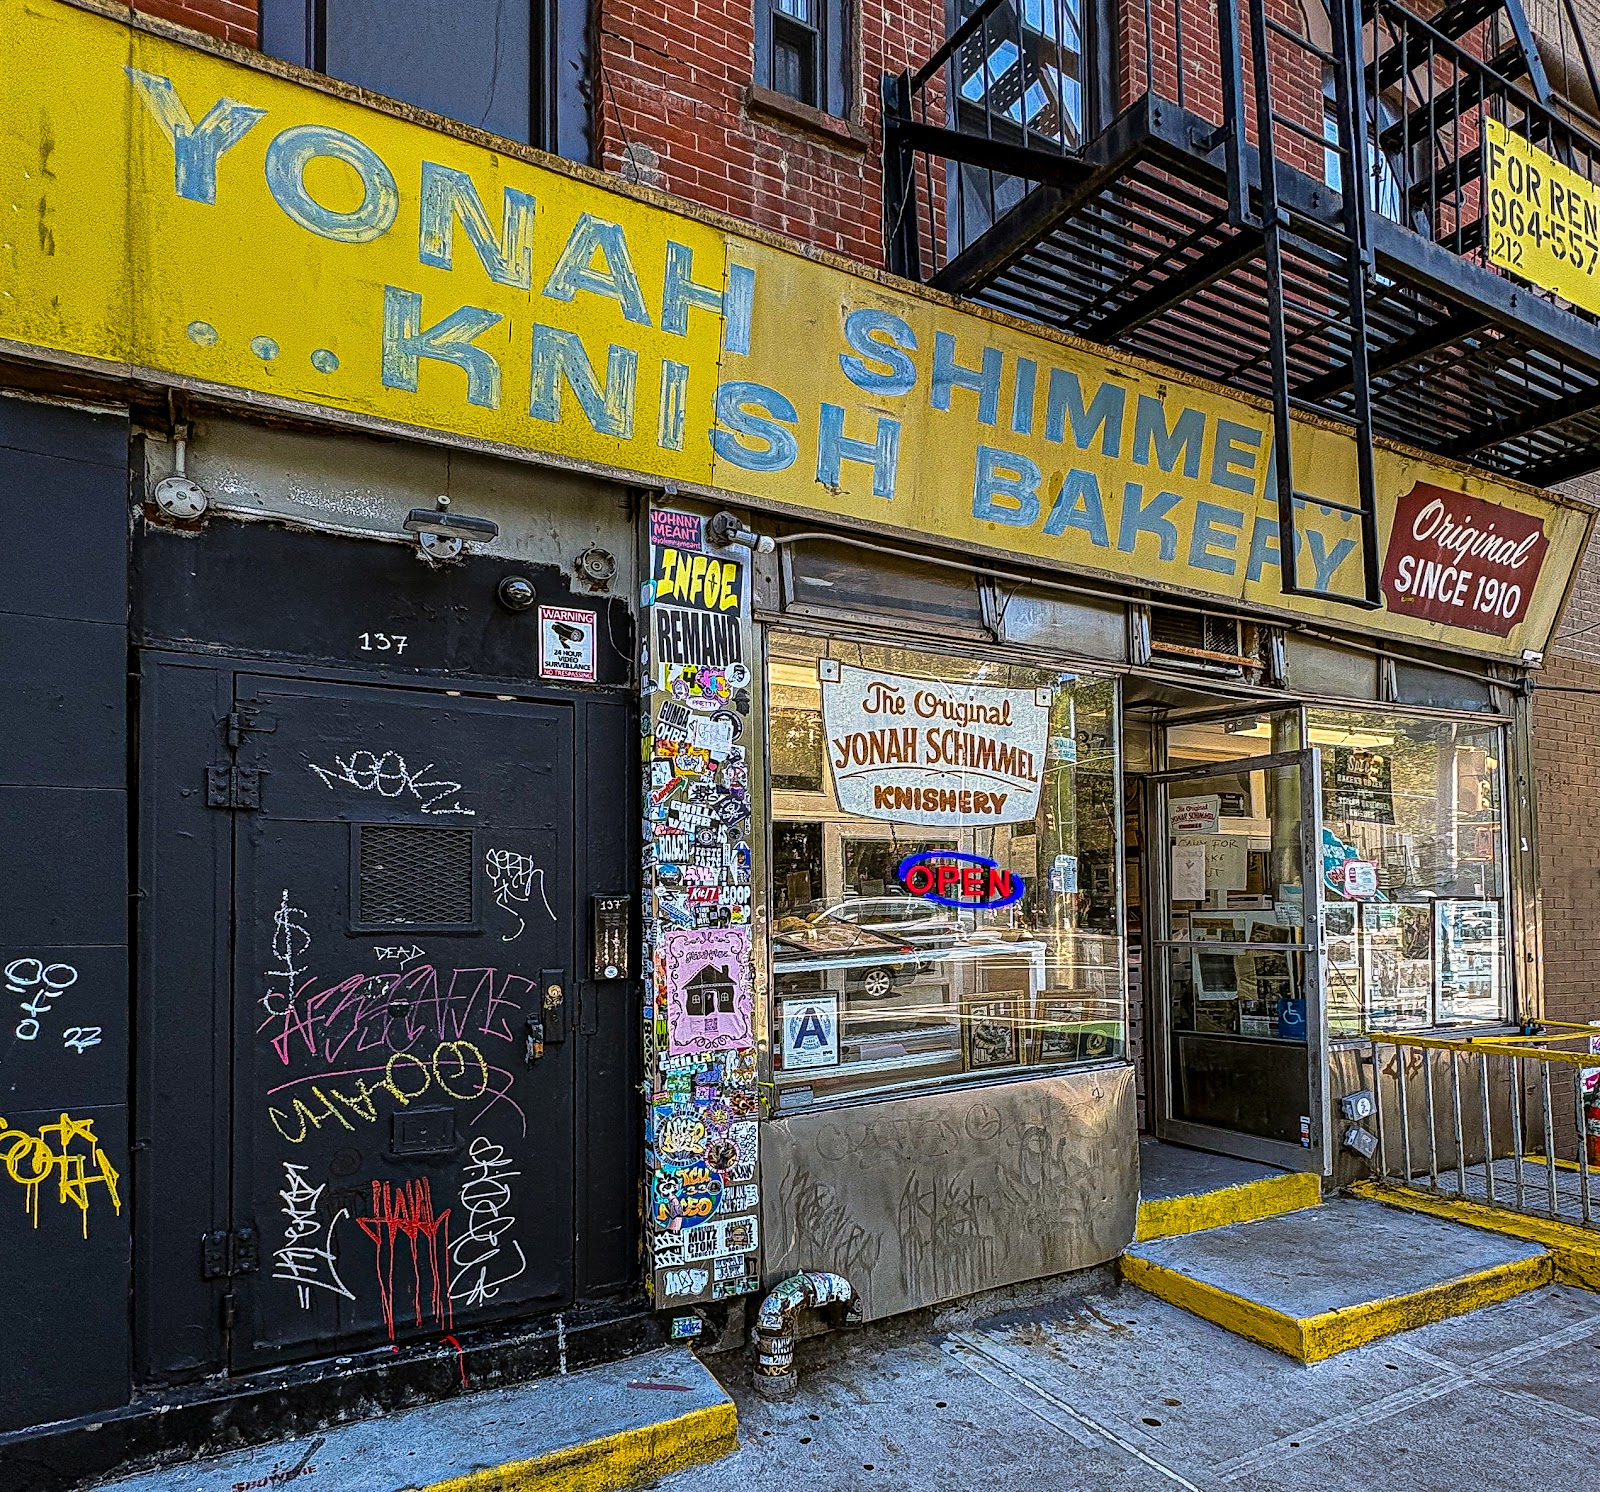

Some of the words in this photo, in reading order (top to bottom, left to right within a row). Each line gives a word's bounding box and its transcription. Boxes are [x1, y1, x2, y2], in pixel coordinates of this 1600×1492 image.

[124, 65, 756, 357] YONAH
[1490, 142, 1541, 208] FOR
[1550, 178, 1600, 241] REN
[381, 285, 900, 499] KNISH
[972, 445, 1358, 592] BAKERY
[651, 511, 699, 528] JOHNNY
[654, 523, 698, 541] MEANT
[1413, 498, 1540, 569] Original
[656, 549, 739, 611] INFOE
[1394, 555, 1473, 606] SINCE
[1473, 576, 1521, 619] 1910
[543, 609, 593, 623] WARNING
[657, 608, 741, 666] REMAND
[359, 632, 409, 654] 137
[545, 661, 591, 670] SURVEILLANCE
[555, 670, 592, 679] TRESPASSING
[863, 681, 906, 715] The
[914, 689, 1013, 727] Original
[832, 727, 918, 769] YONAH
[926, 727, 1038, 783] SCHIMMEL
[874, 785, 1008, 815] KNISHERY
[905, 865, 1011, 898] OPEN
[373, 944, 426, 969] DEAD
[793, 1007, 829, 1049] A
